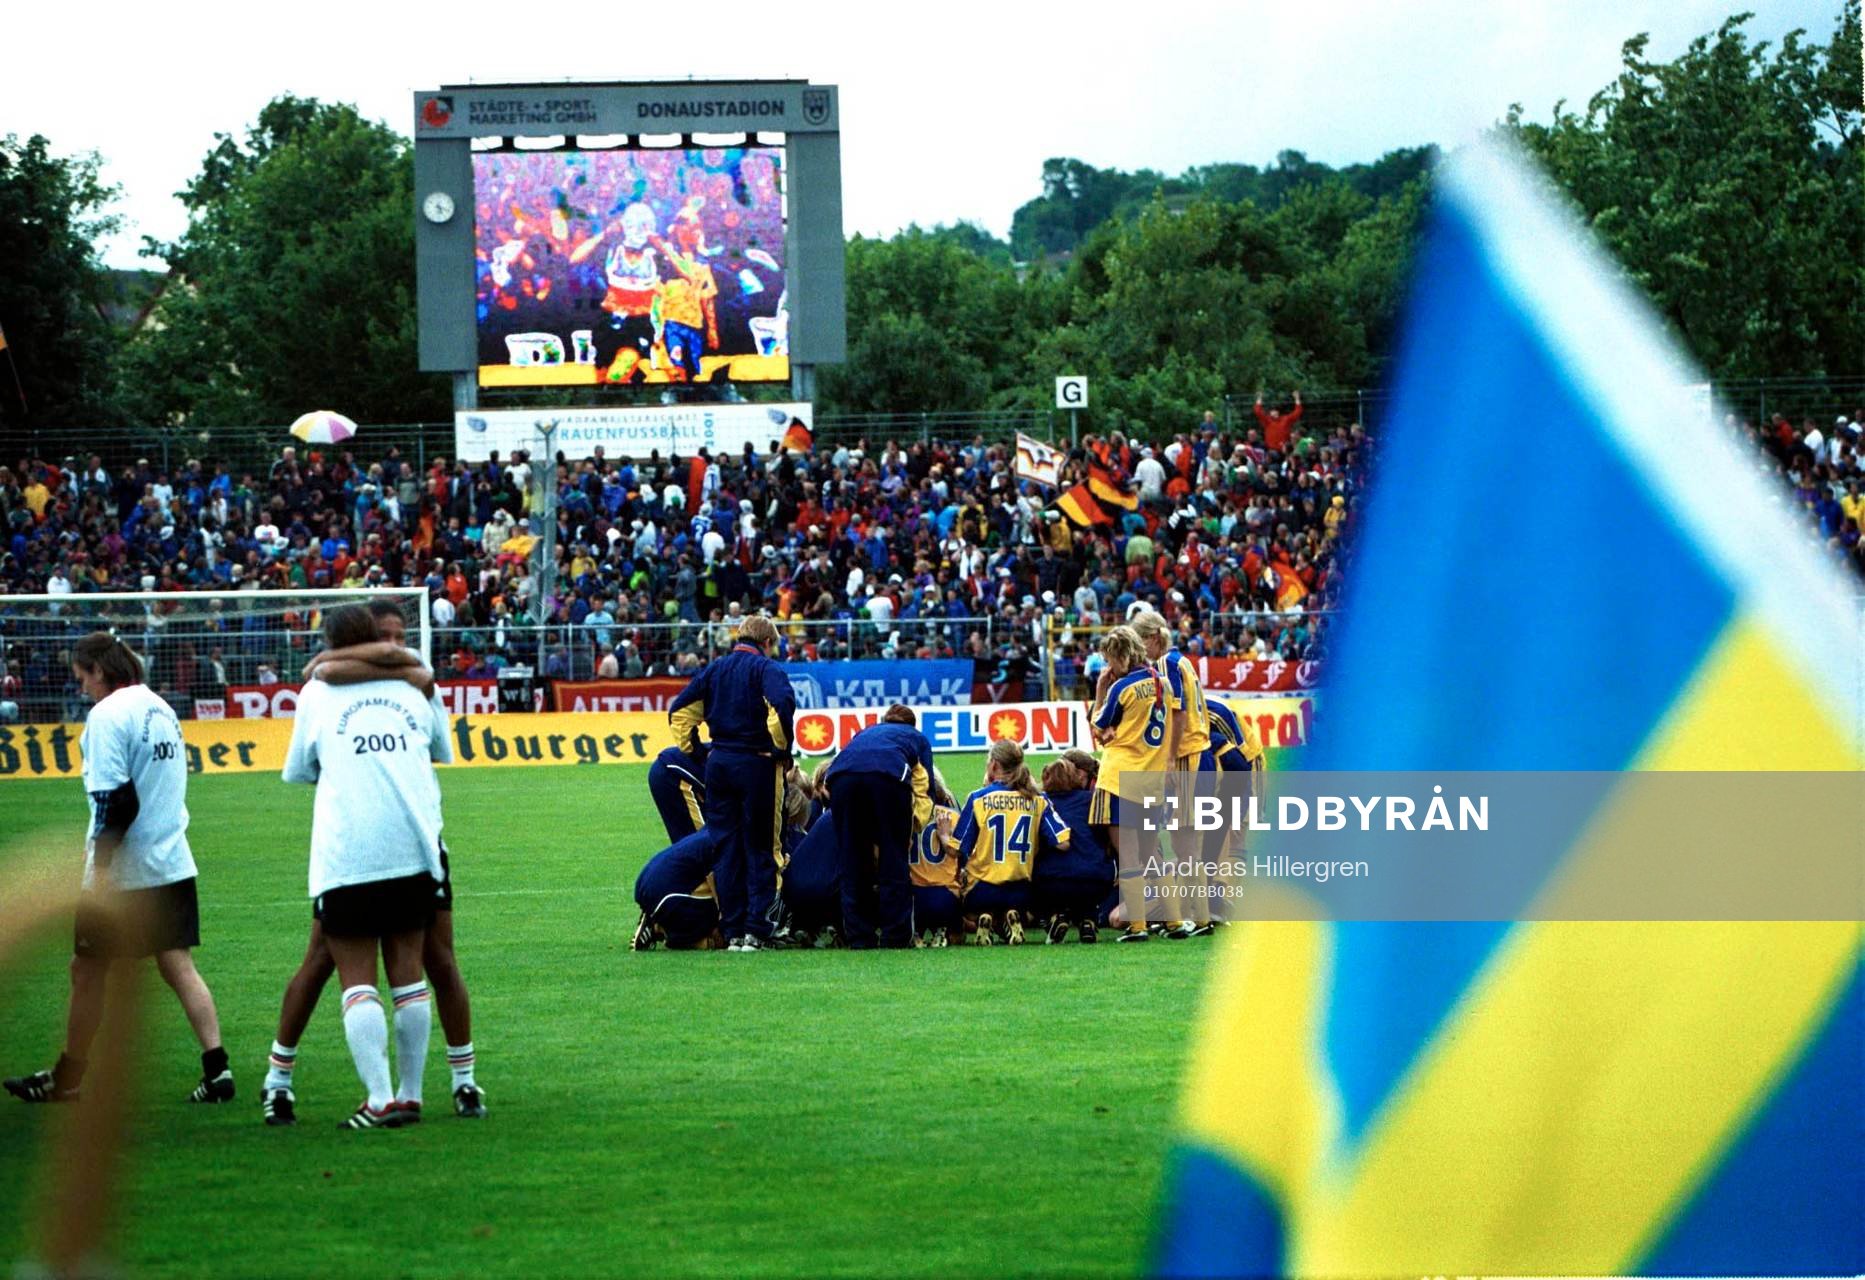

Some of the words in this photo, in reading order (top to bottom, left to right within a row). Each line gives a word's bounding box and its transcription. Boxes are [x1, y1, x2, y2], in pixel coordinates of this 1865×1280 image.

[469, 112, 552, 124] MARKETING
[637, 100, 785, 118] DONAUSTADION
[1062, 381, 1082, 403] G
[555, 425, 698, 441] RAUENFUSSBALL
[337, 698, 418, 735] EUROPAMEISTER
[1143, 699, 1168, 748] 8
[353, 733, 407, 755] 2001
[452, 716, 649, 764] tburger
[987, 814, 1032, 864] 14
